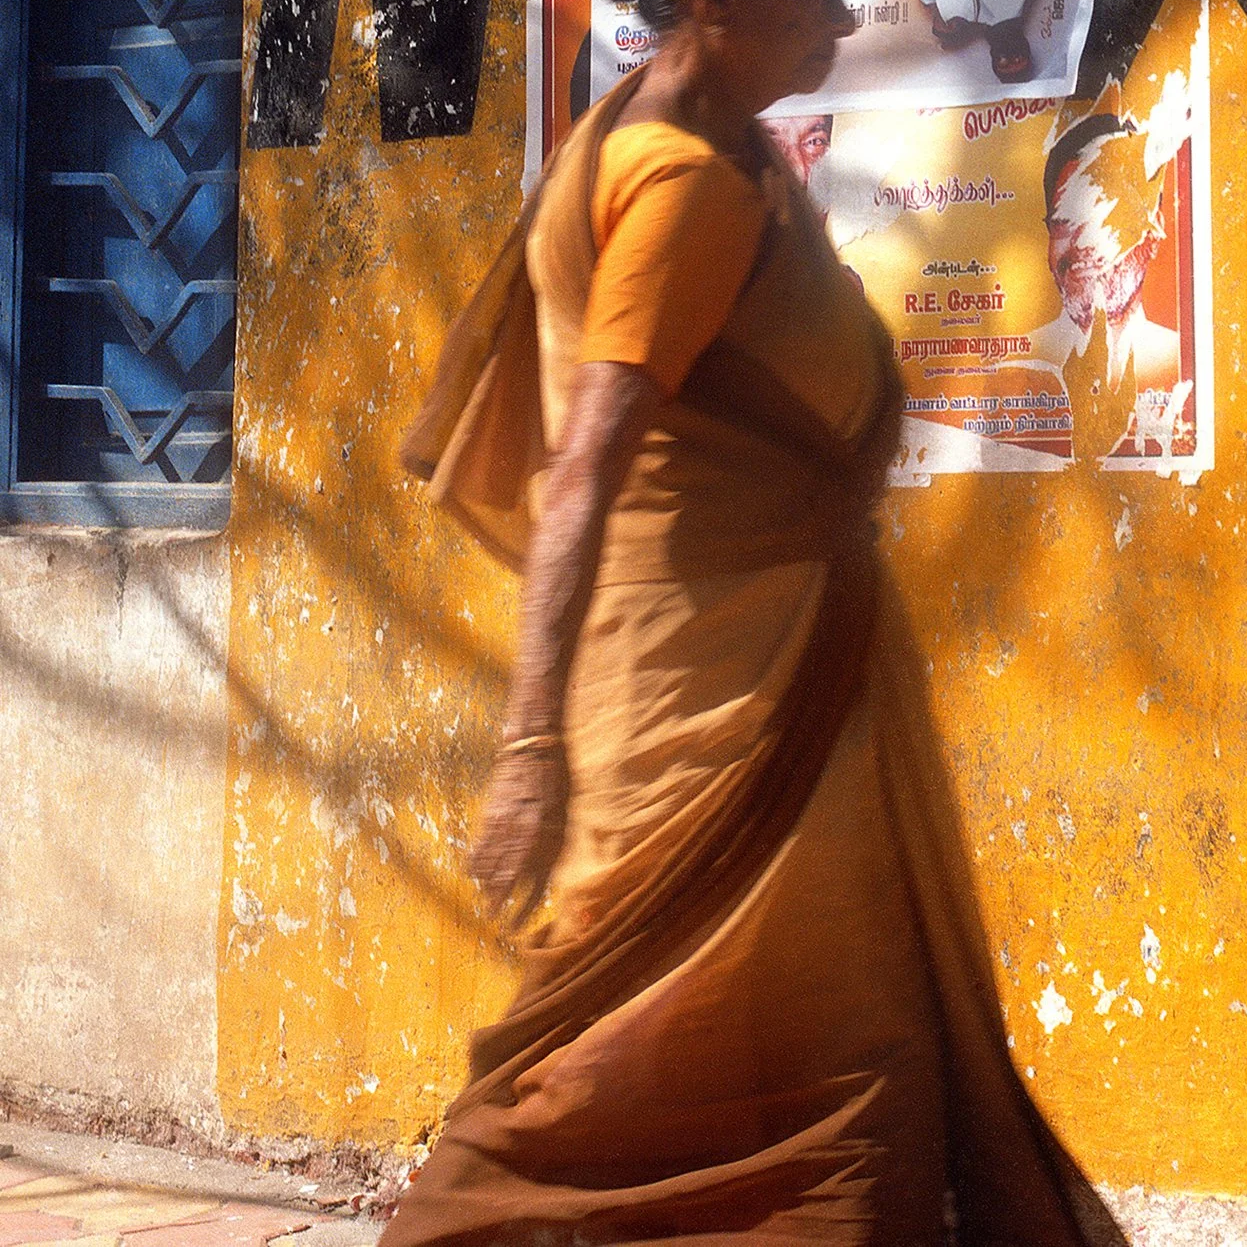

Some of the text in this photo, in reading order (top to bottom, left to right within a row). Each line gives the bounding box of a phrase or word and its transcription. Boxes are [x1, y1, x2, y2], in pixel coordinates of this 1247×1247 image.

[904, 283, 1007, 314] R.E. சேகர்
[1013, 412, 1073, 435] நிர்வாகி
